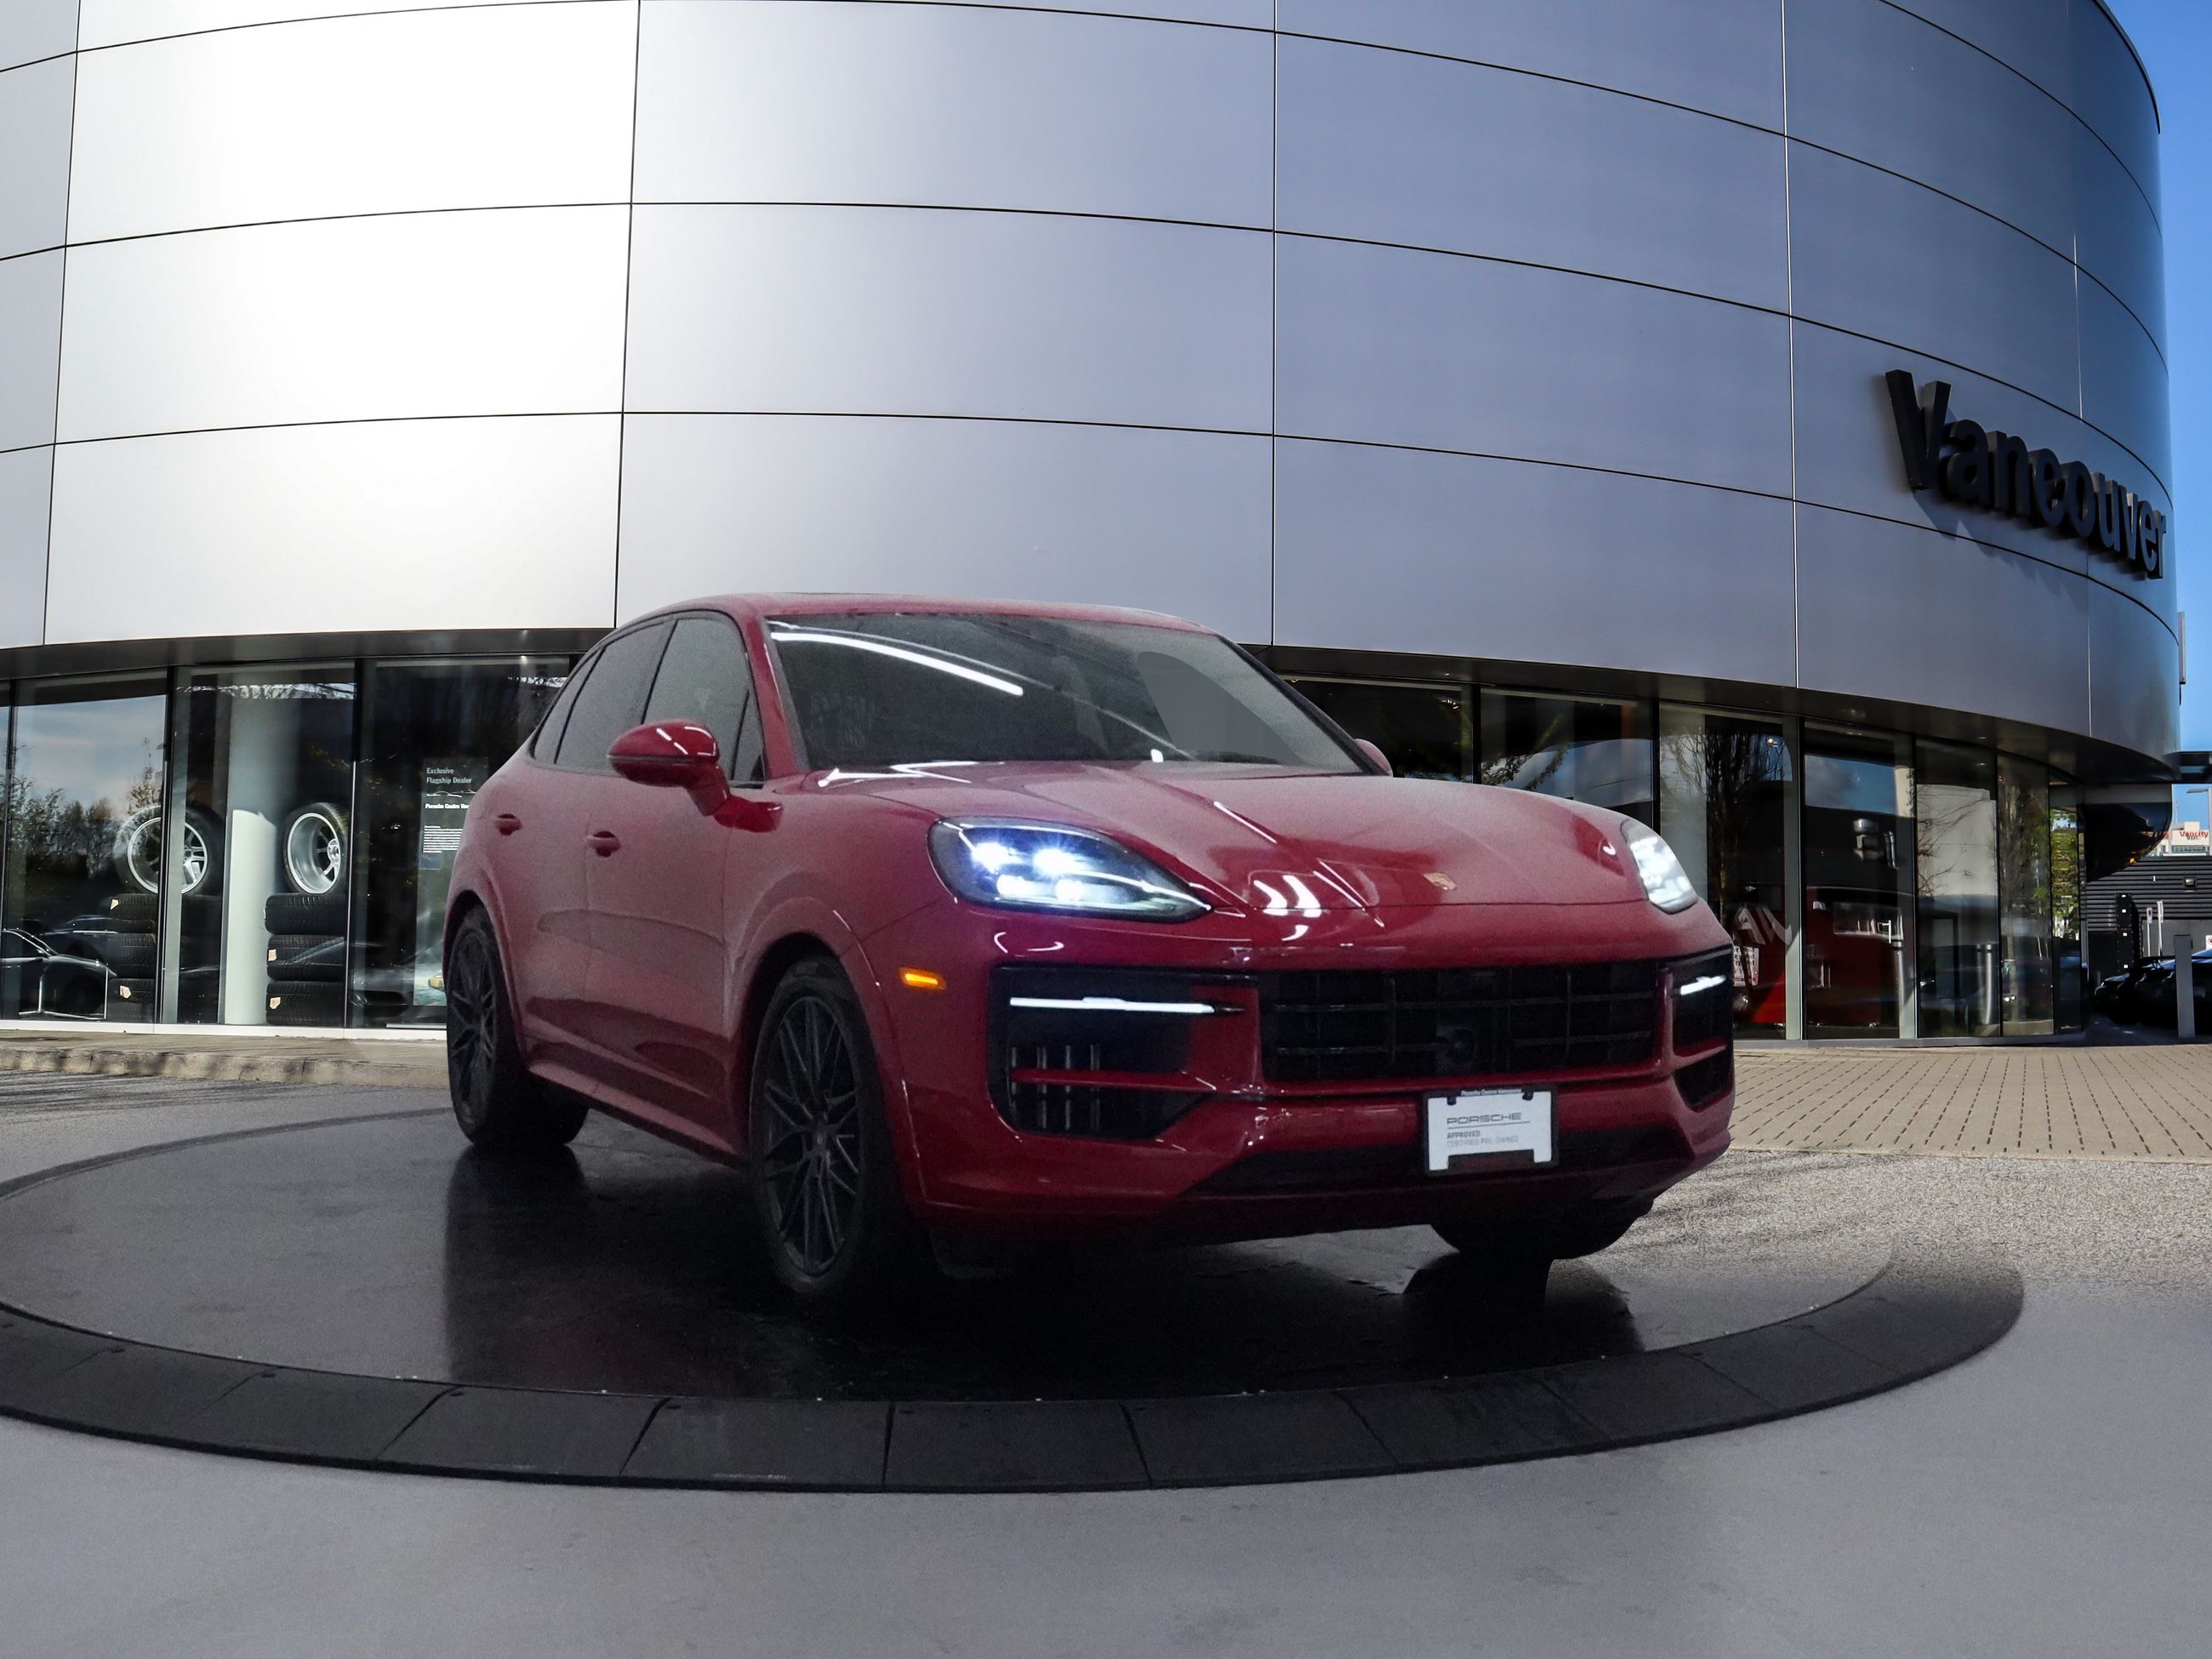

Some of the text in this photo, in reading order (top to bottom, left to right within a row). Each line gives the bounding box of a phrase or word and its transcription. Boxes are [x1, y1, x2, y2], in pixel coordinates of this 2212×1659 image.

[1885, 369, 2167, 579] Vancouver
[1446, 1112, 1522, 1124] PORSCHE
[1446, 1130, 1480, 1138] APPROVED
